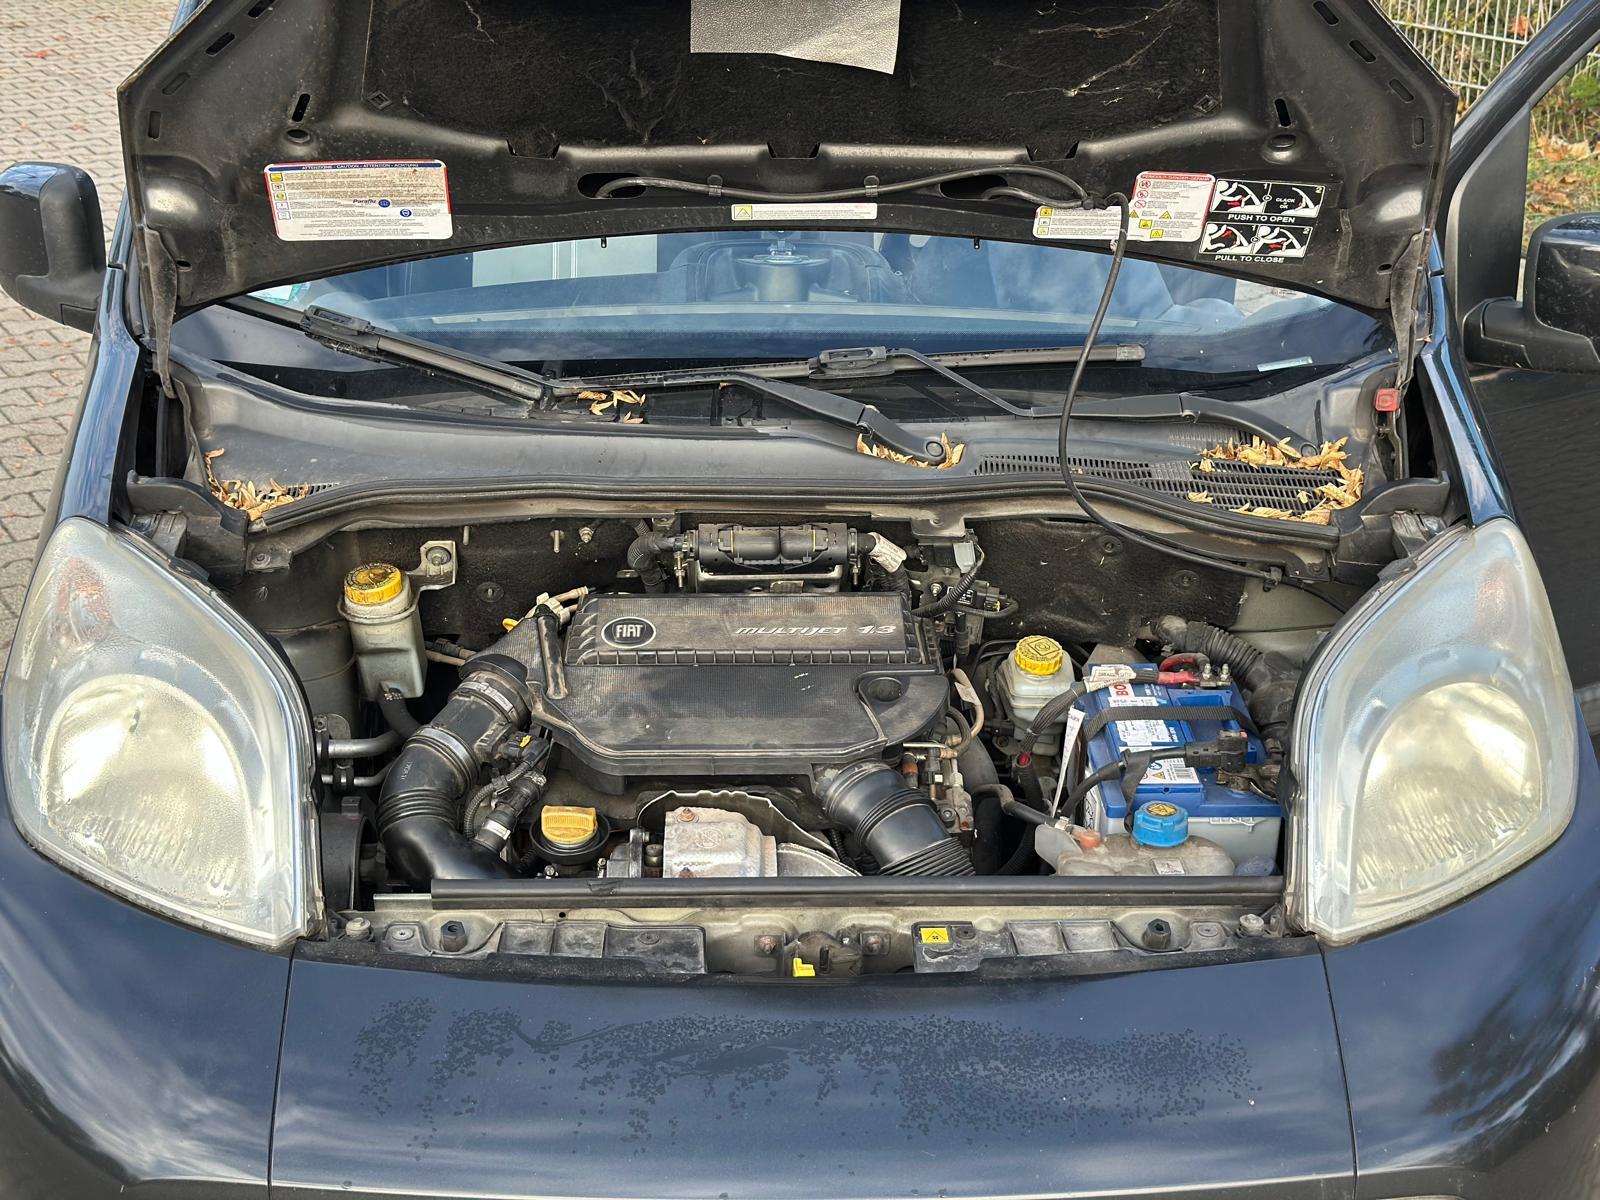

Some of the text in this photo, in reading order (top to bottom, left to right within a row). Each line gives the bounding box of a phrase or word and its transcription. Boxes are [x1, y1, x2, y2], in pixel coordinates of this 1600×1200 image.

[1227, 213, 1255, 221] PUSH
[1269, 215, 1296, 223] OPEN
[616, 624, 643, 638] FIAT
[858, 625, 897, 634] 1.3
